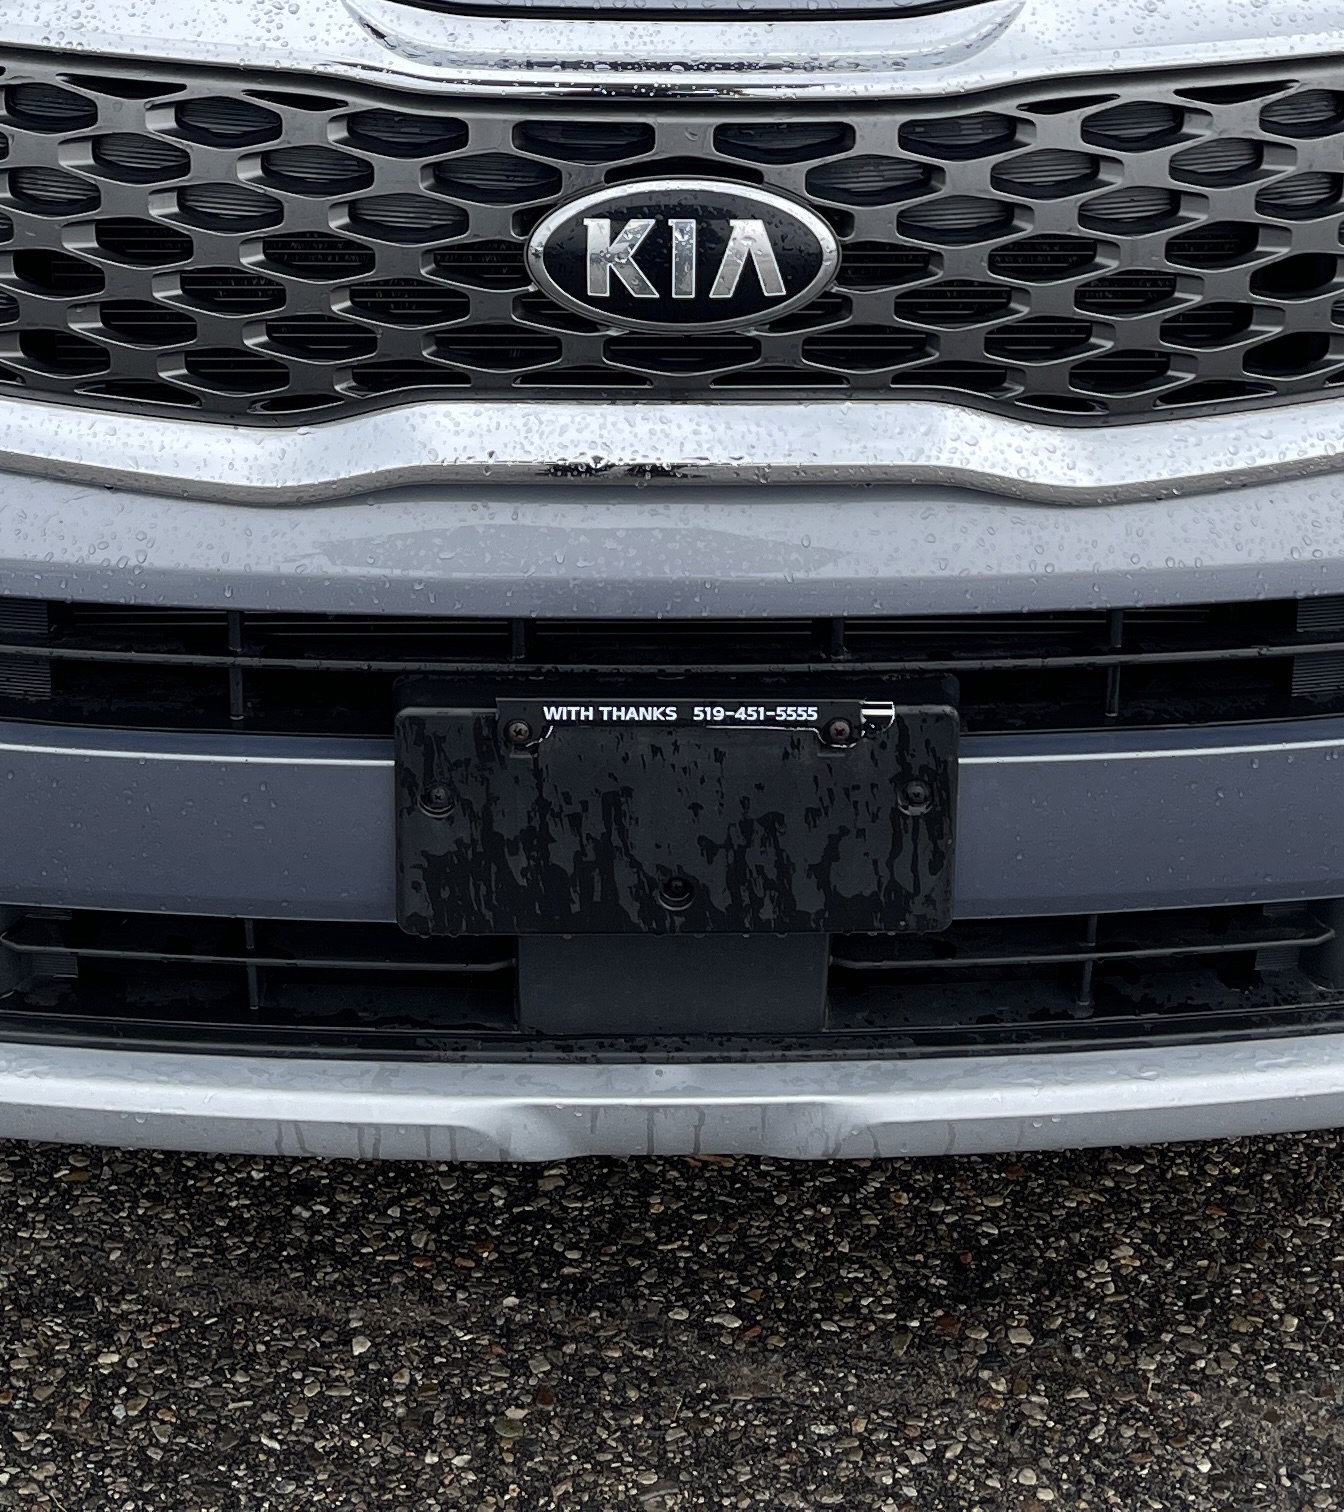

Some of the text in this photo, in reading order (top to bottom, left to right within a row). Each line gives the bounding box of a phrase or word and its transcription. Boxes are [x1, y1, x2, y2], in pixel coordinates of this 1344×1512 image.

[582, 218, 787, 299] KIA
[542, 706, 819, 722] WITH THANKS 519-451-5555
